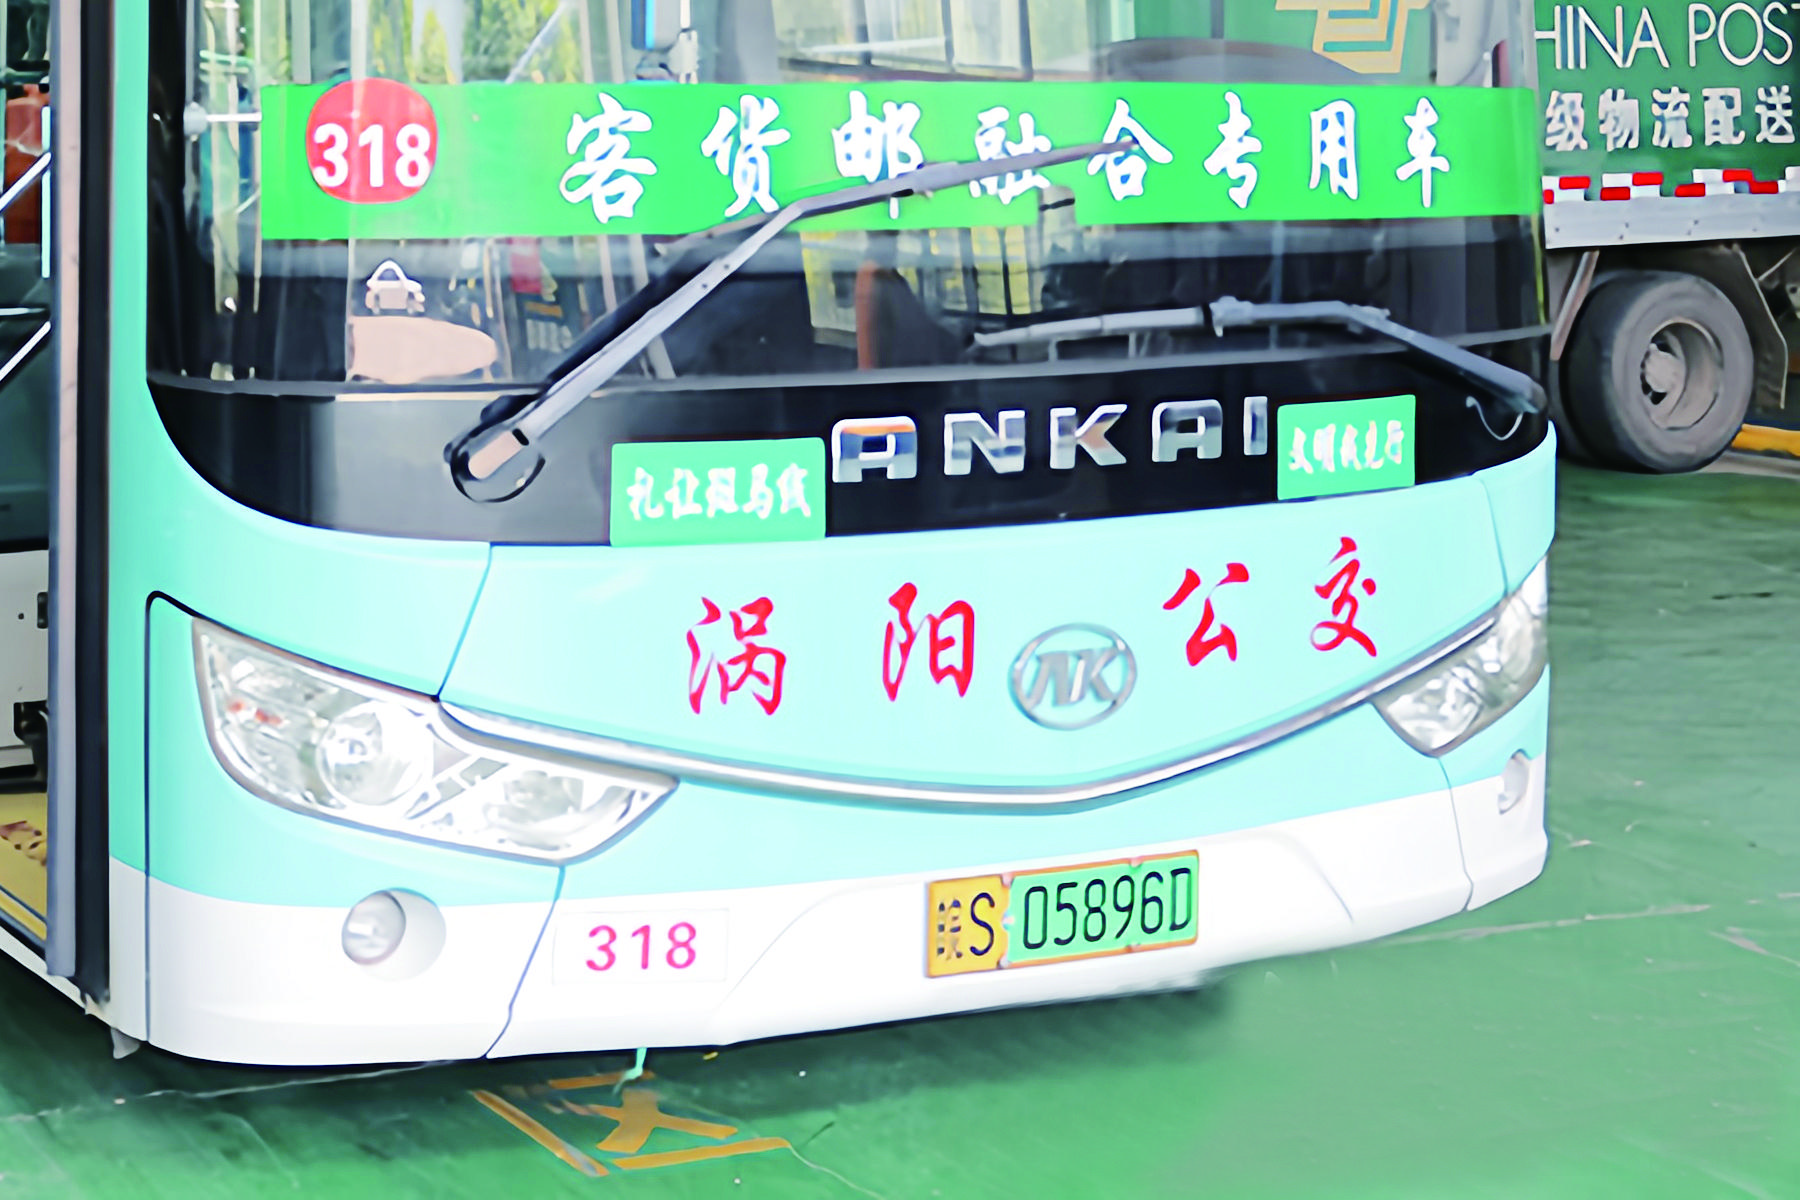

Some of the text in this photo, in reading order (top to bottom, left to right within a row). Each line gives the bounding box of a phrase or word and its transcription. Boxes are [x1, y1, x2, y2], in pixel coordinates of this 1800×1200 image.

[1688, 2, 1800, 68] POS
[313, 122, 431, 188] 318
[559, 90, 1451, 224] 客货邮融合专用车
[832, 396, 1268, 482] ANKAI
[585, 922, 698, 972] 318
